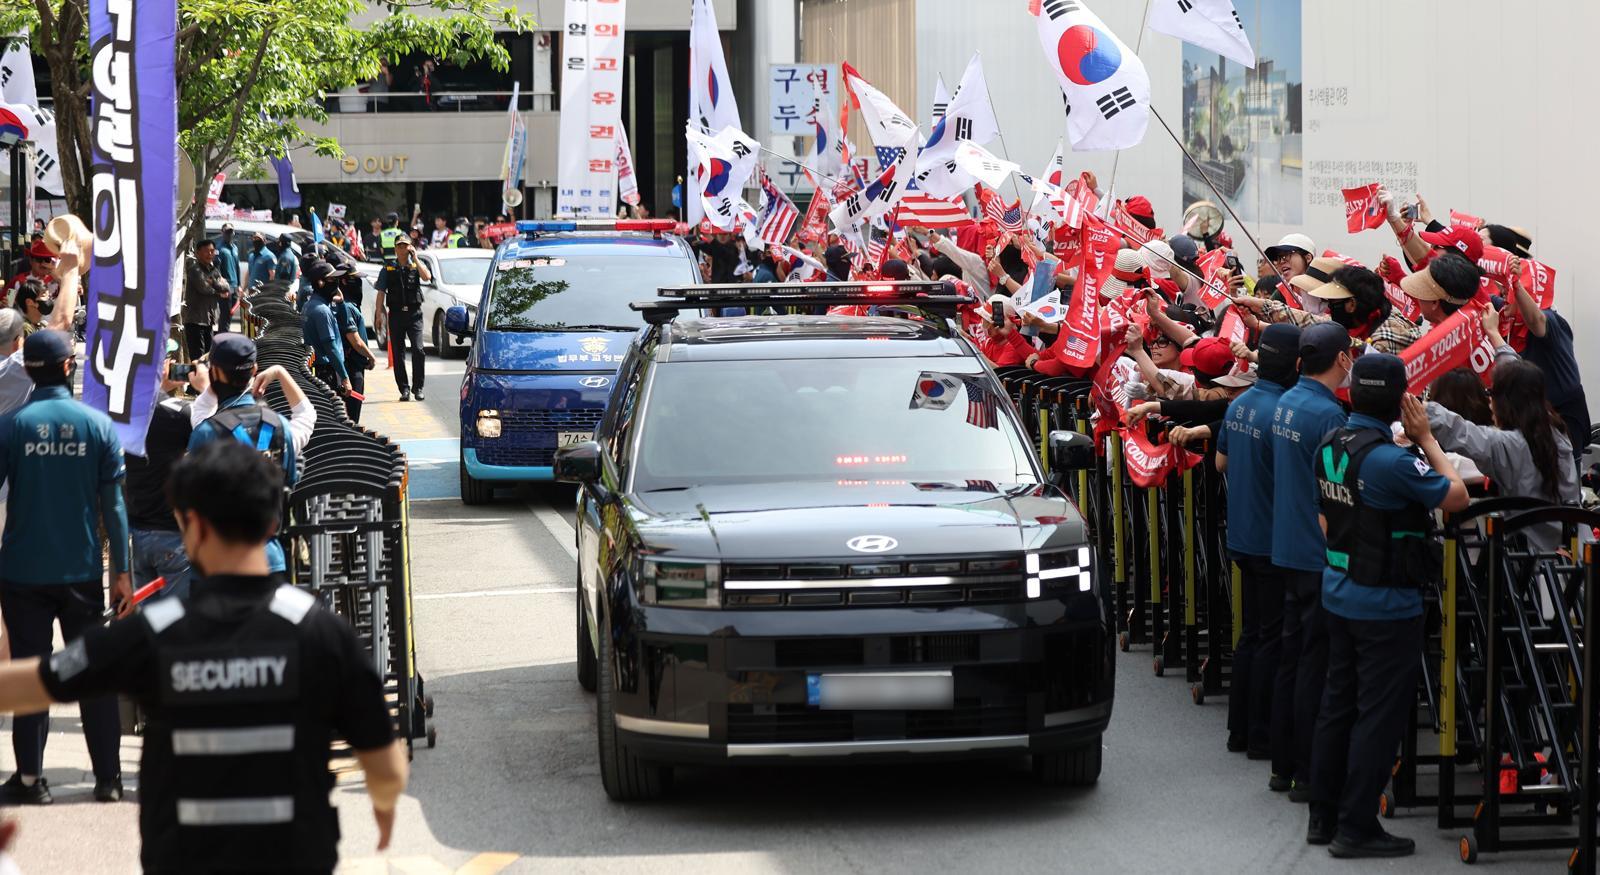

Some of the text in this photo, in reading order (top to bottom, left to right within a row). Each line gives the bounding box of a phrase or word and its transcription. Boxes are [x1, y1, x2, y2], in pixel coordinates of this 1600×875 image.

[363, 154, 408, 174] OUT
[1225, 420, 1262, 440] POLICE
[1272, 424, 1301, 443] OLICE
[25, 442, 87, 457] POLICE
[1319, 479, 1355, 506] POLICE
[171, 656, 287, 692] SECURITY
